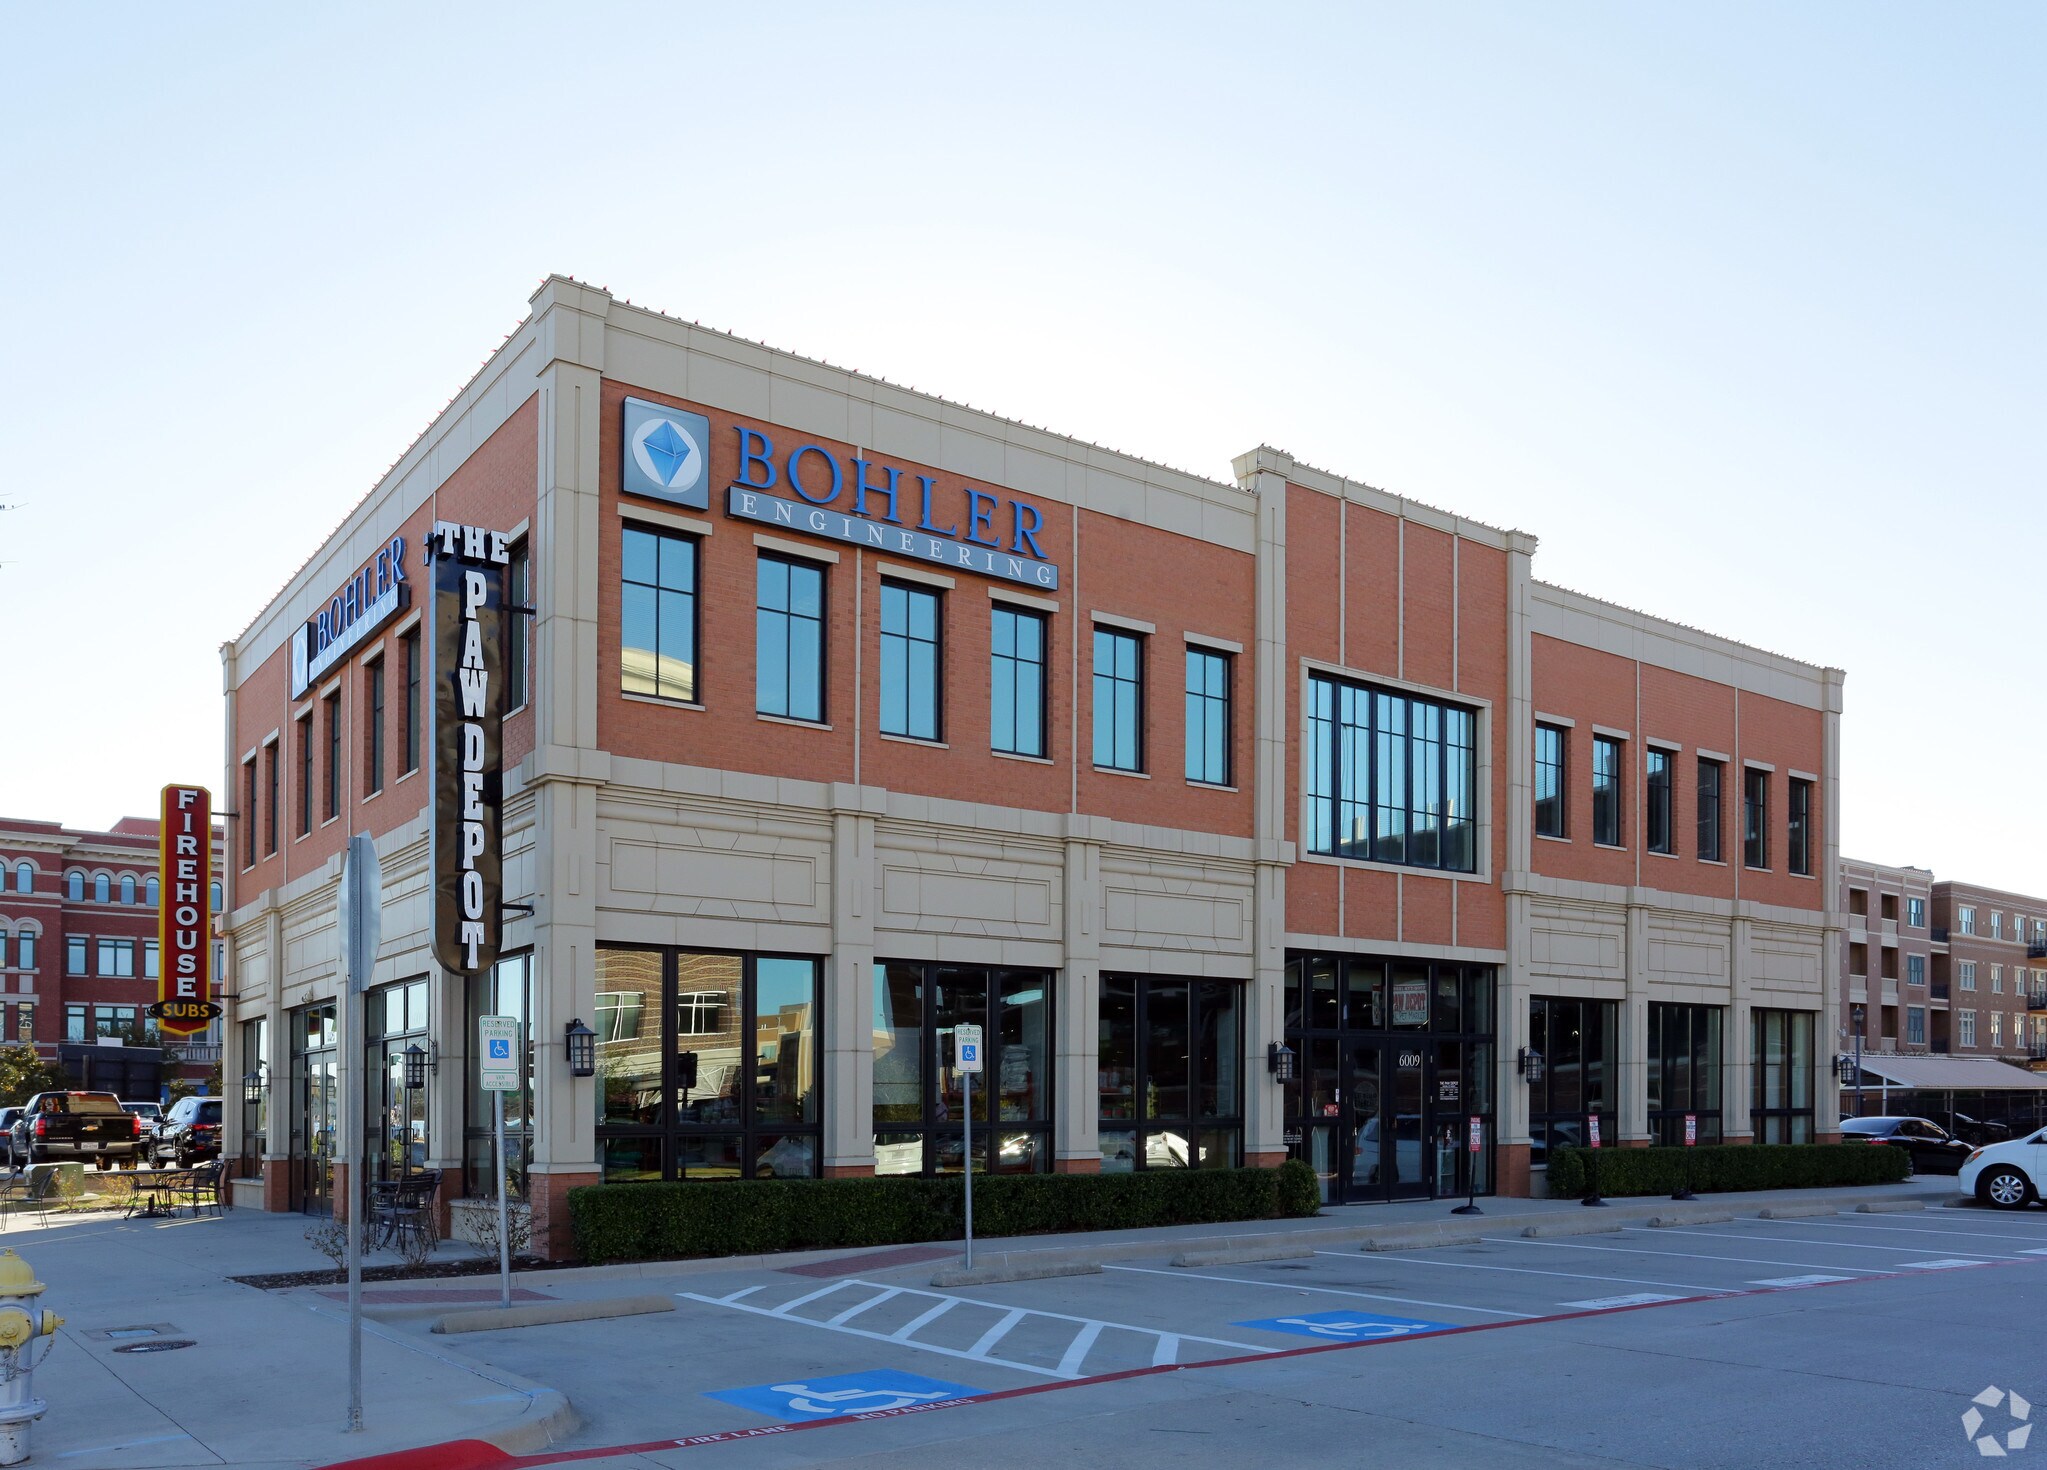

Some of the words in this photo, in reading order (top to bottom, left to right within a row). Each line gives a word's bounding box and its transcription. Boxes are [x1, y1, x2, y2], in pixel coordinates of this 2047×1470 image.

[732, 426, 1049, 559] BOHLER
[434, 519, 510, 566] THE
[740, 493, 1052, 585] ENGINEERING
[316, 535, 407, 656] BOHLER
[309, 590, 398, 678] ENGINEERING
[175, 789, 199, 999] FIREHOUSE
[161, 1003, 210, 1018] SUBS
[482, 1020, 515, 1028] RESERVED
[484, 1029, 513, 1038] PARKING
[957, 1028, 981, 1036] RESERVED
[958, 1036, 979, 1044] PARKING
[1399, 1054, 1421, 1067] 6009
[853, 1410, 887, 1421] NO
[889, 1397, 977, 1417] PARKING
[672, 1432, 730, 1447] FIRE
[731, 1424, 795, 1439] LANE
